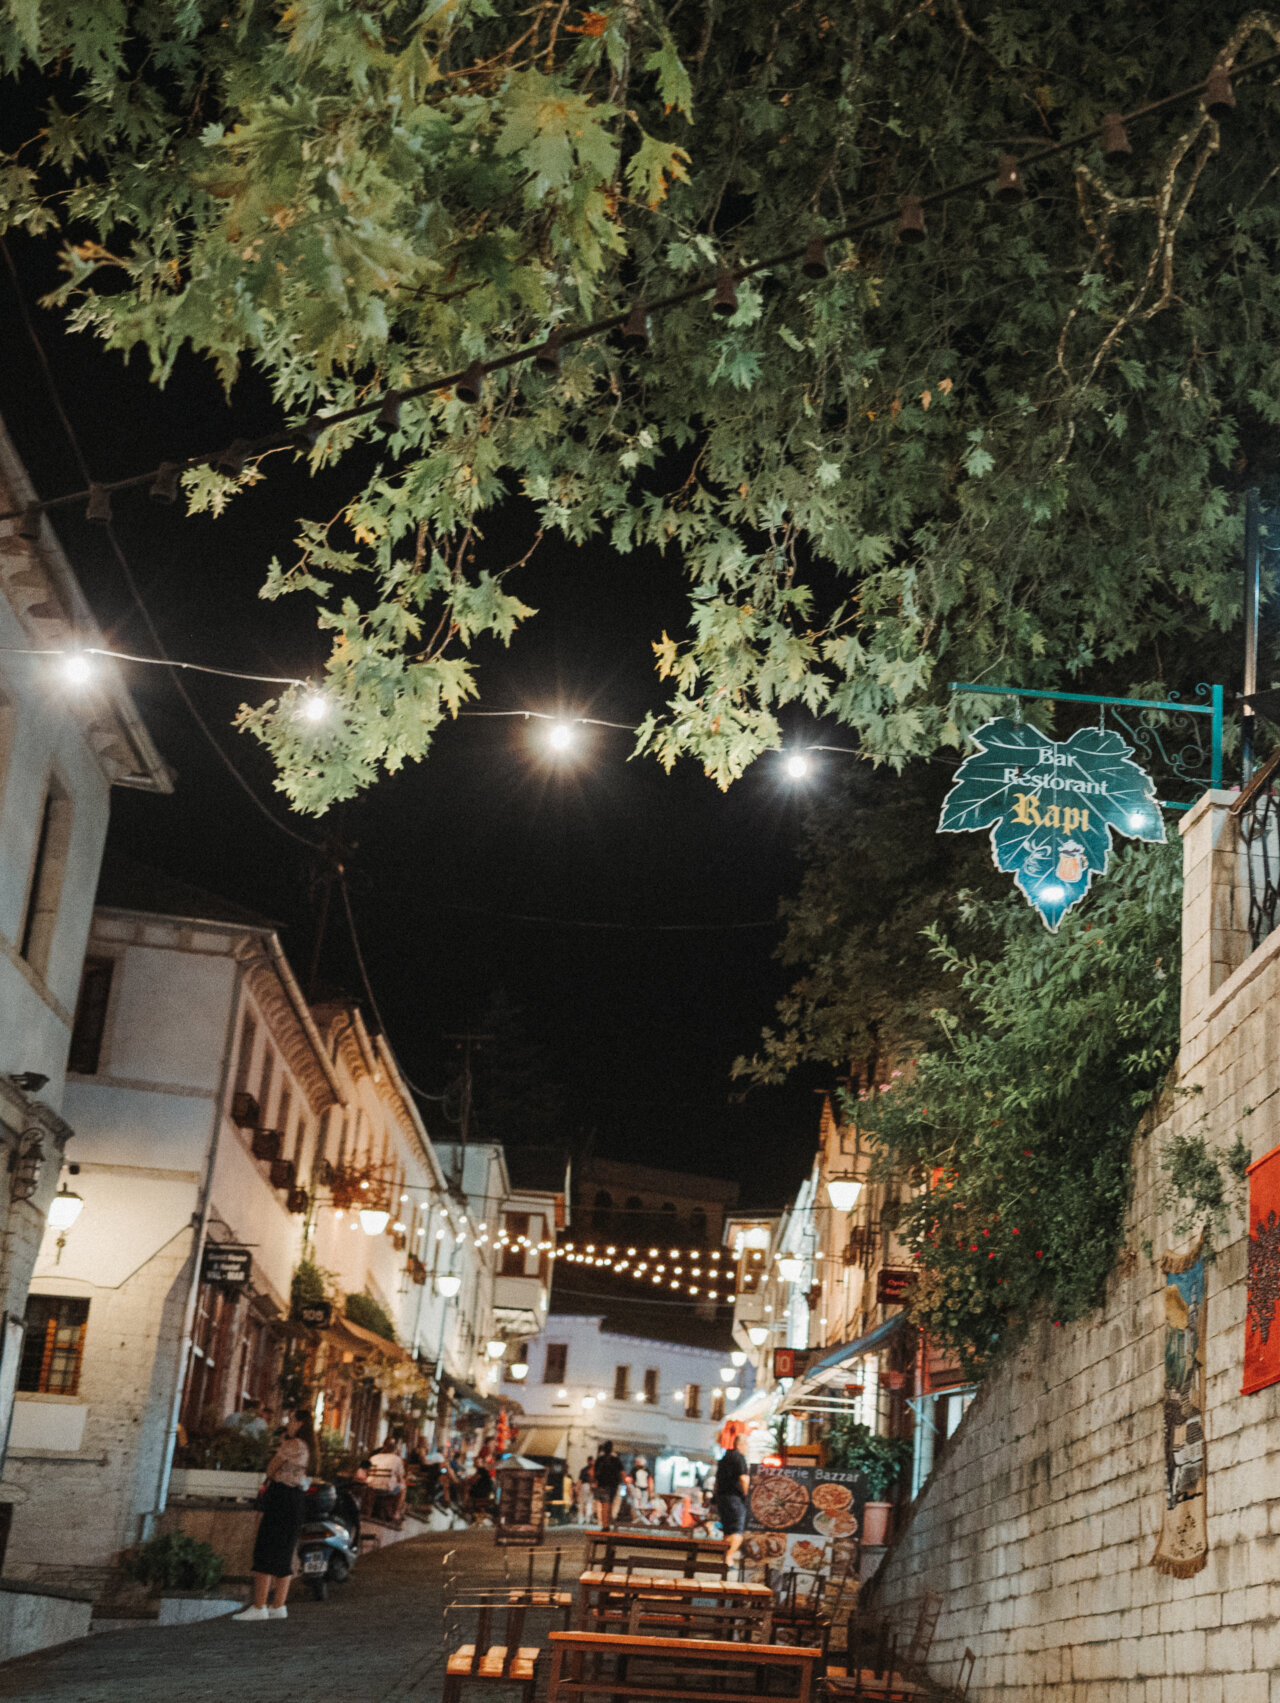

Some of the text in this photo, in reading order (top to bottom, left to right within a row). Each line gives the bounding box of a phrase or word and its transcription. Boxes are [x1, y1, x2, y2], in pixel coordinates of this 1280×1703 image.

[1039, 748, 1077, 767] Bar
[1003, 768, 1108, 795] Restorant
[1010, 793, 1090, 836] Rapi
[757, 1465, 859, 1482] Pizzerie Bazzar
